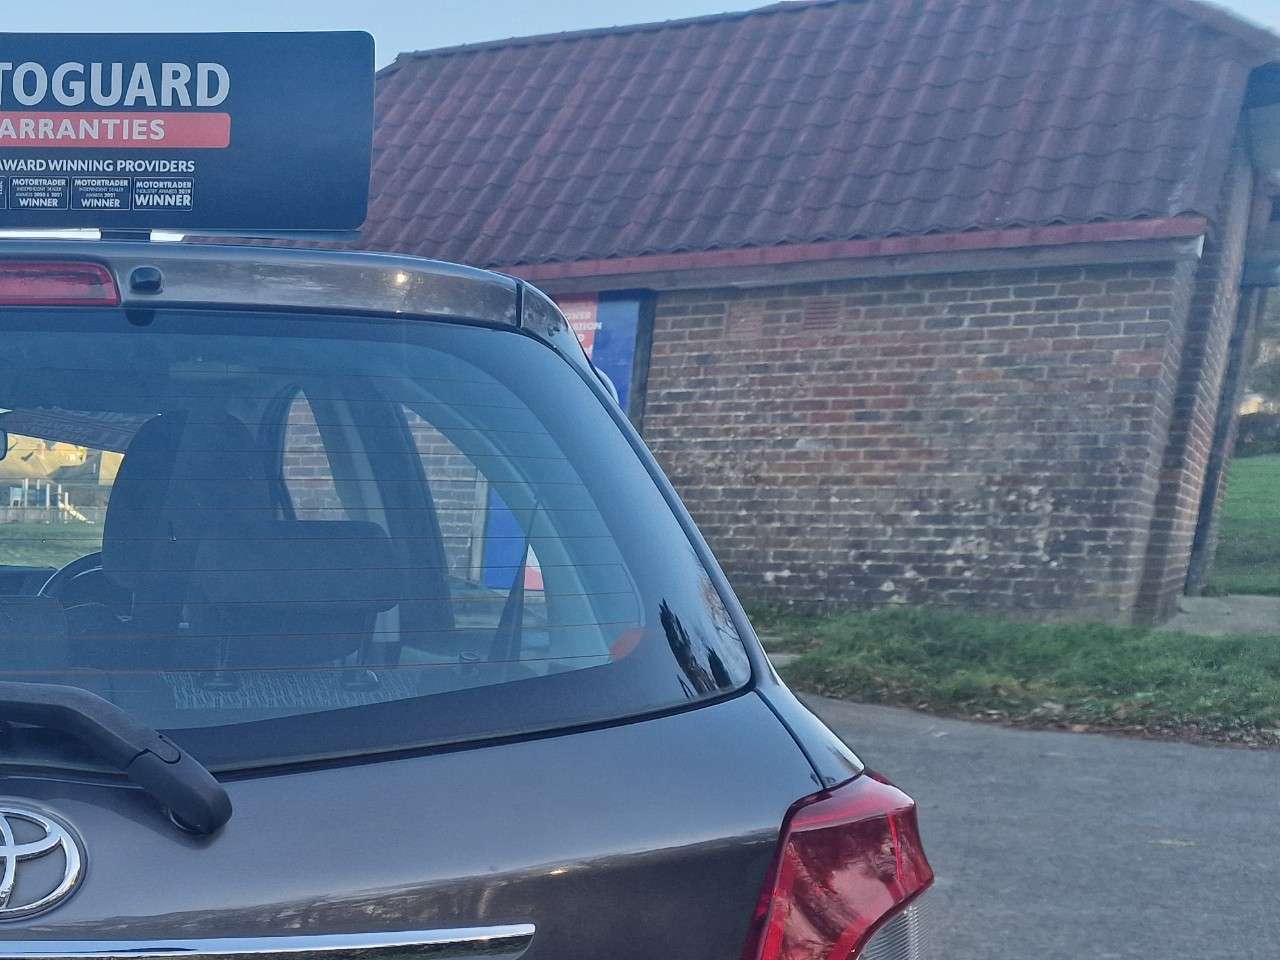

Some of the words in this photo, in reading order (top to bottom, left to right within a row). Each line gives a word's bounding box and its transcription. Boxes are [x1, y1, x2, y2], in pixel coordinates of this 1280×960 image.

[48, 159, 114, 172] WINNING
[116, 159, 195, 173] PROVIDERS
[12, 178, 66, 186] MOTORTRADER
[74, 179, 129, 187] MOTORTRADER
[136, 181, 192, 189] MOTORTRADER
[19, 198, 59, 207] WINNER
[81, 198, 121, 208] WINNER
[135, 194, 191, 206] WINNER
